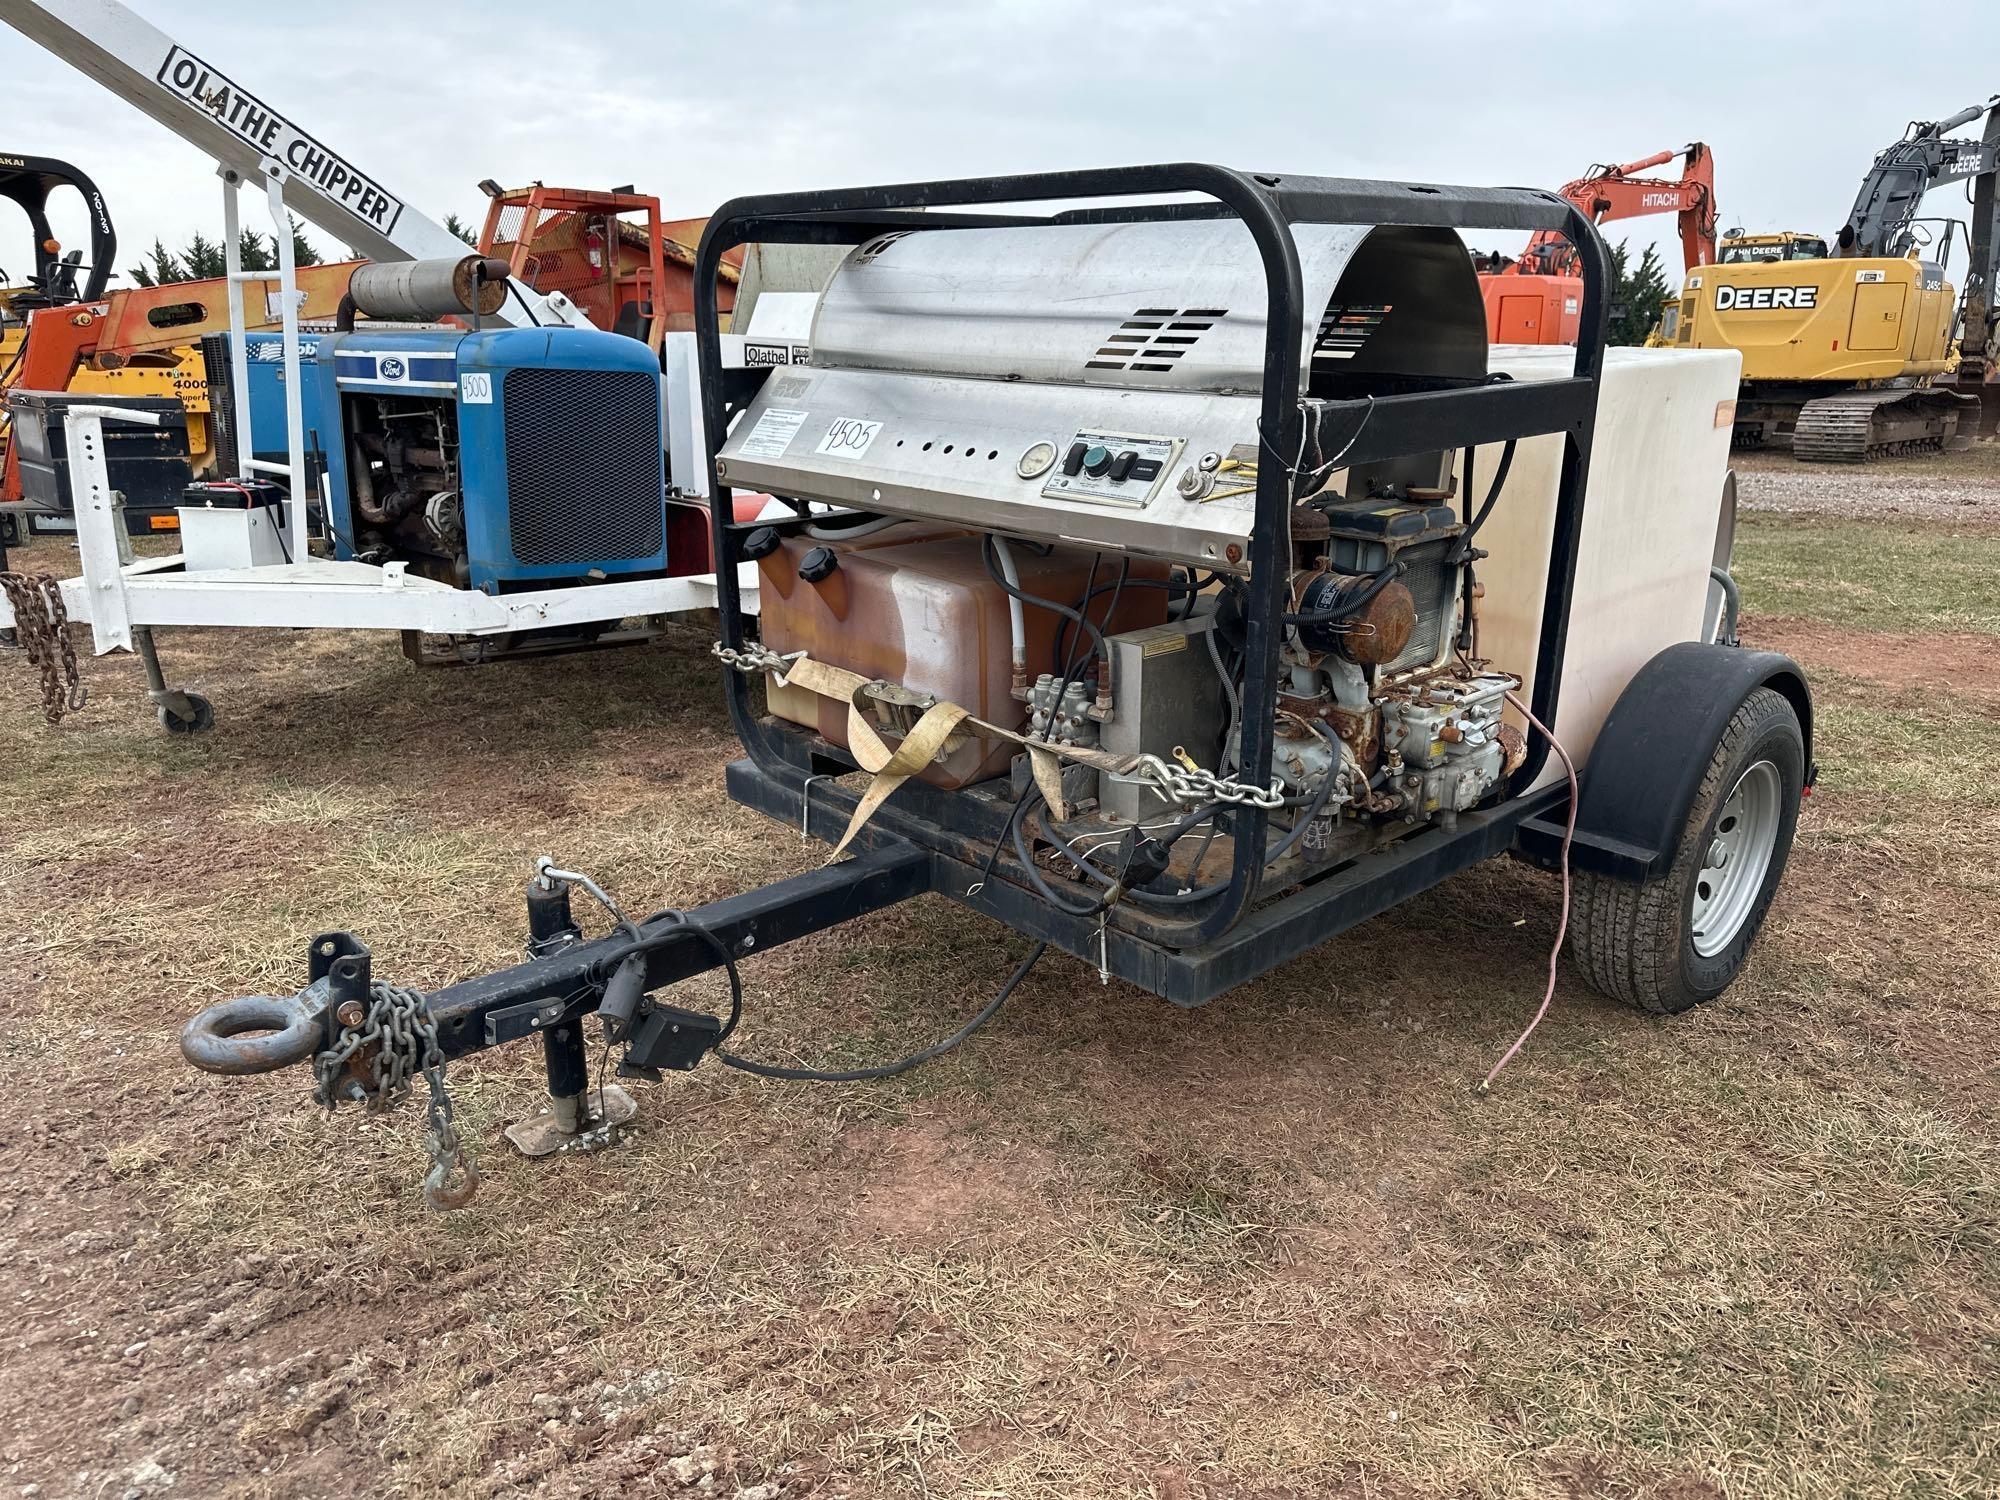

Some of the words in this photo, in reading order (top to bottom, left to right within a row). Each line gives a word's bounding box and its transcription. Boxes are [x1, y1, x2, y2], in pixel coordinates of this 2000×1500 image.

[173, 59, 282, 150] OLATHE
[287, 139, 389, 226] CHIPPER
[1642, 192, 1680, 207] HITACHI
[92, 191, 110, 234] 20123
[1752, 246, 1783, 255] DEERE
[1715, 285, 1819, 311] DEERE
[748, 347, 785, 362] Olathe
[384, 360, 401, 376] Ford
[173, 380, 208, 389] 4000
[463, 374, 488, 400] 4500
[825, 420, 877, 451] 4505
